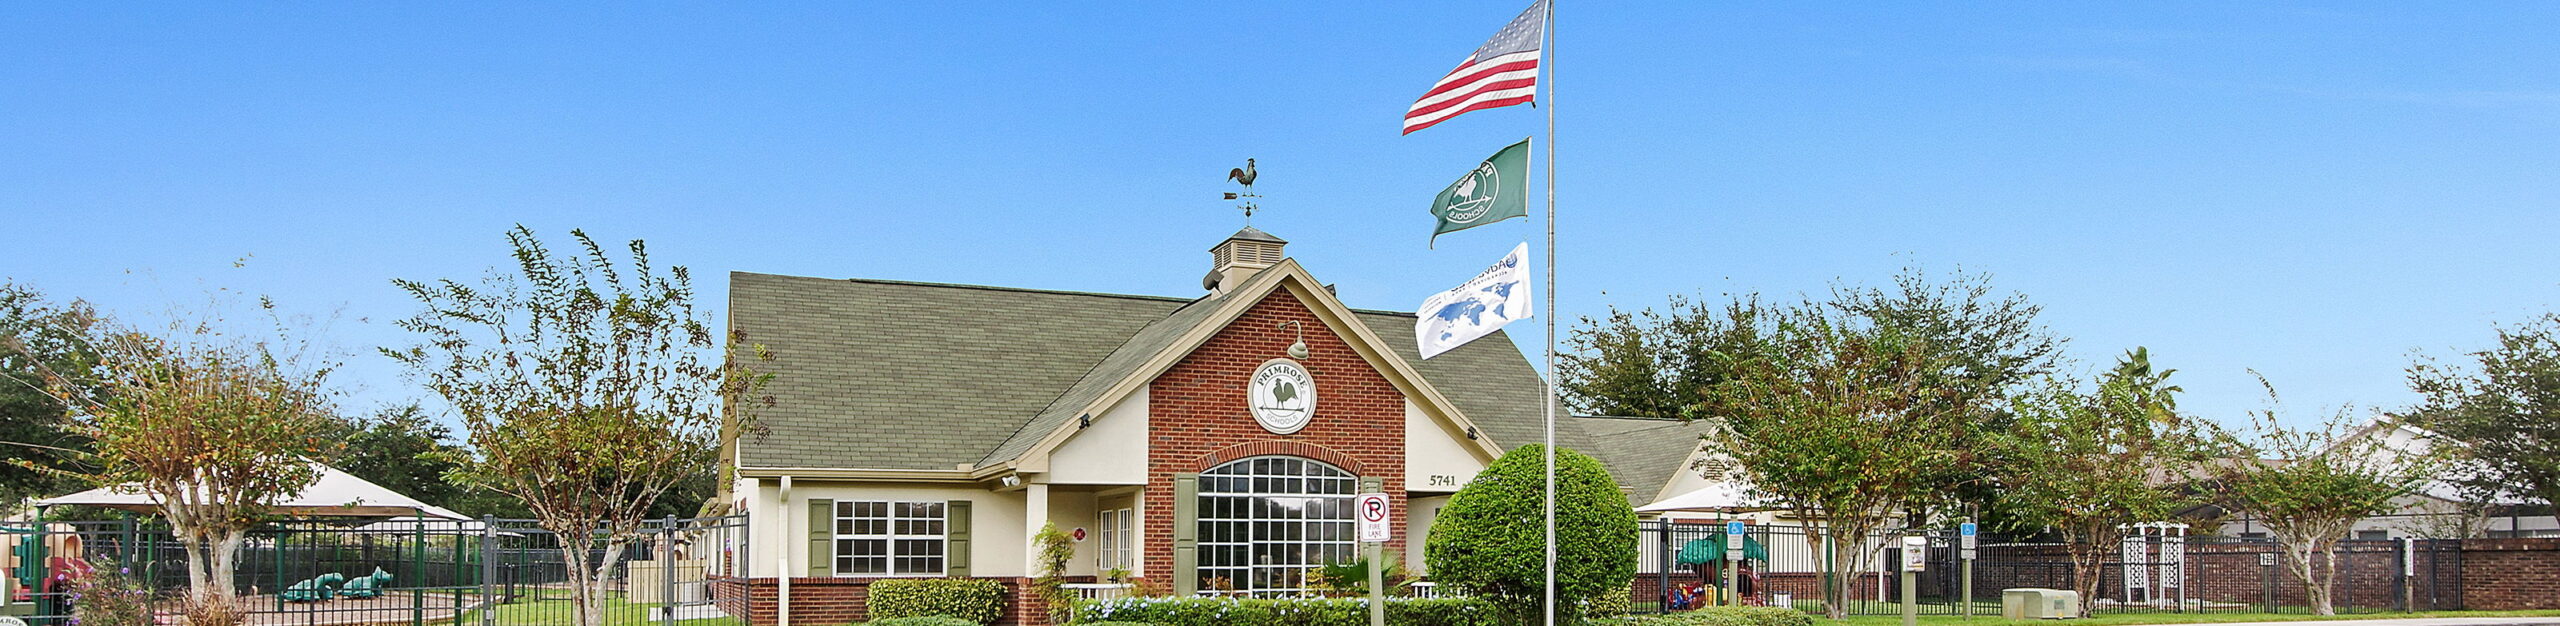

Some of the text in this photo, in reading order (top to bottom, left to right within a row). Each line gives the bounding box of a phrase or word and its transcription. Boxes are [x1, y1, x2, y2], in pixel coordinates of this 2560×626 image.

[1257, 366, 1308, 389] PRIMROSE
[1265, 413, 1299, 425] SCHOOLS
[1429, 475, 1456, 486] 5741
